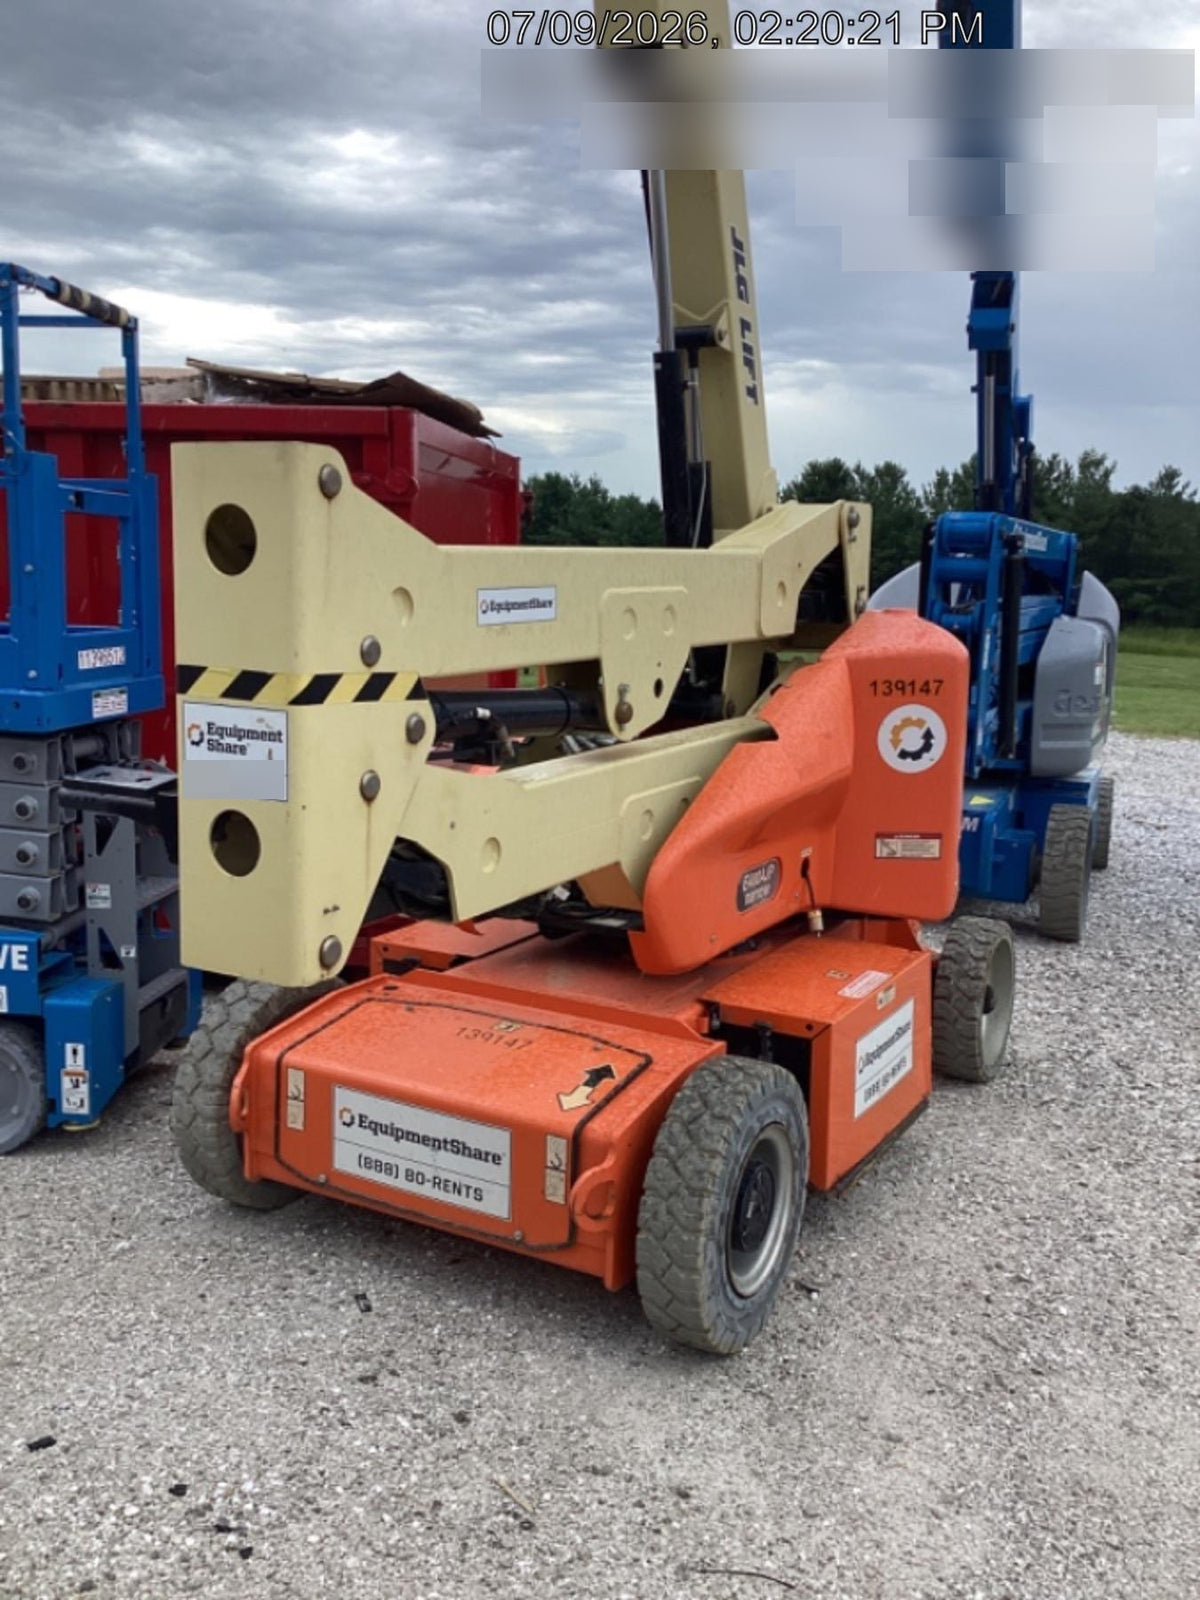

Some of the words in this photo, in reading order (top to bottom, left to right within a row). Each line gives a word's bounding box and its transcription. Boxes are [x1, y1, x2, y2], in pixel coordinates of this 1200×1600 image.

[730, 226, 749, 304] JLG
[739, 316, 759, 406] LIFT
[869, 679, 944, 697] 139147
[207, 721, 283, 743] Equipment
[207, 738, 248, 756] Share
[456, 1027, 532, 1050] 139147
[358, 1113, 503, 1166] EquipmentShare
[358, 1152, 400, 1180] (888)
[404, 1167, 484, 1202] 80-RENTS
